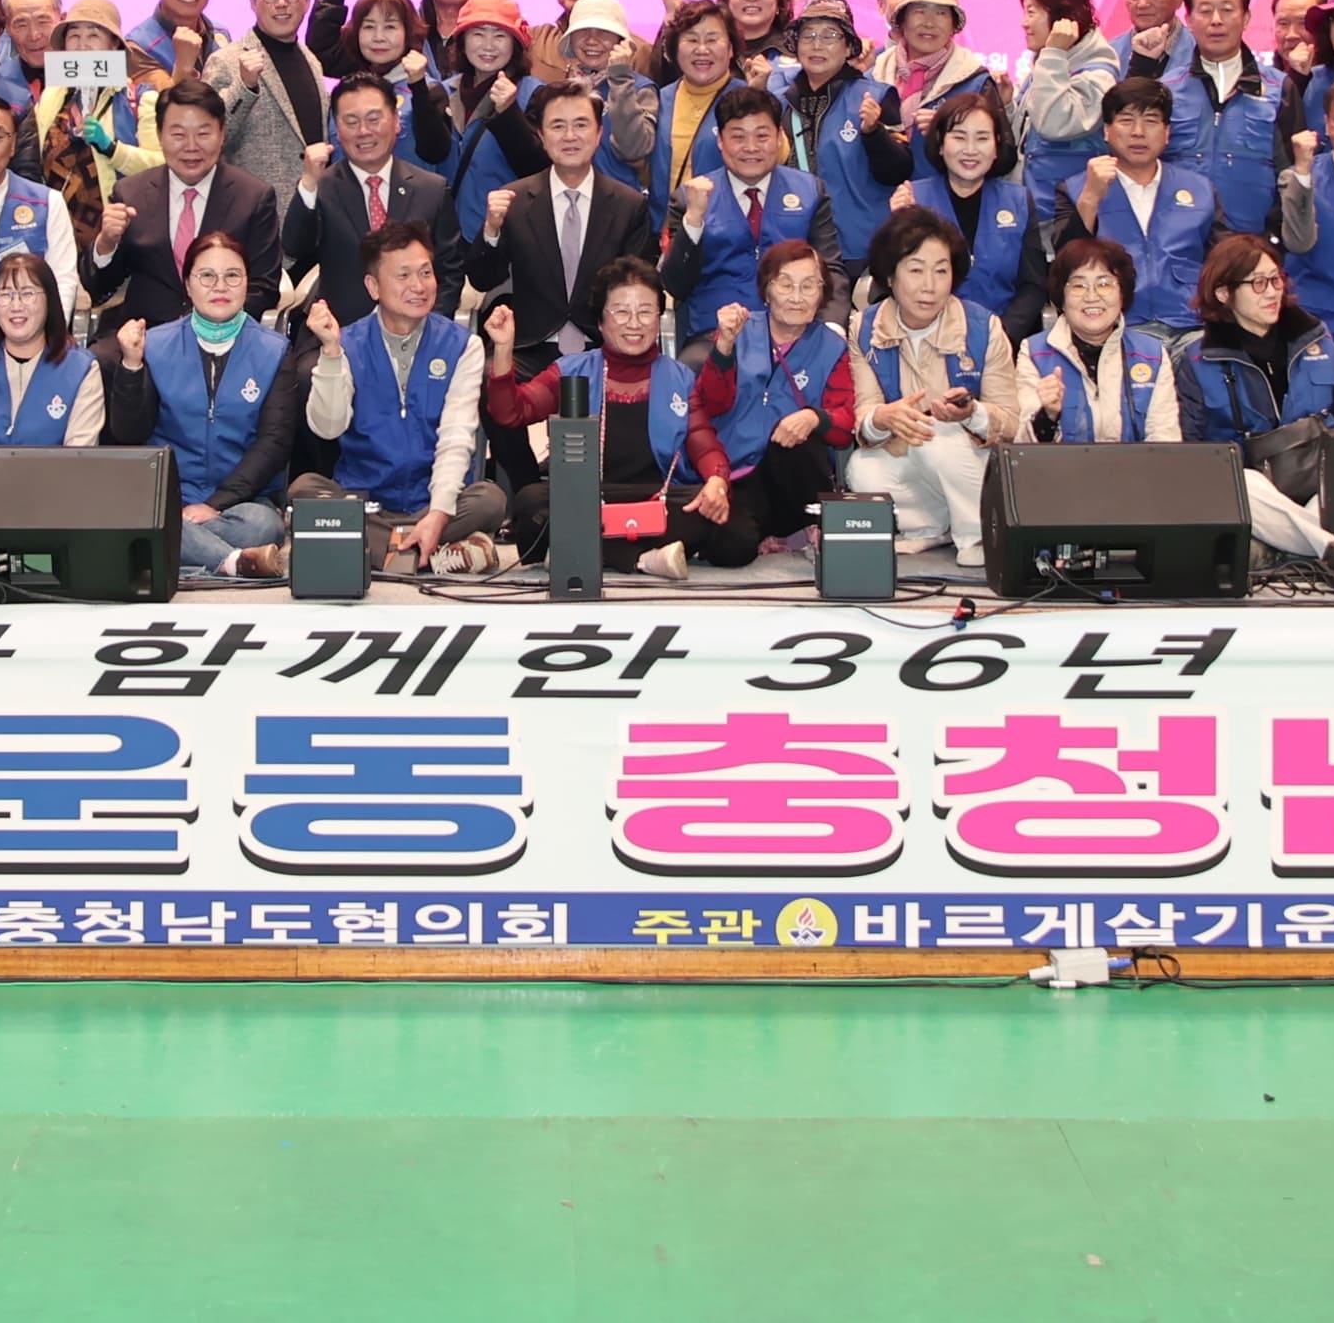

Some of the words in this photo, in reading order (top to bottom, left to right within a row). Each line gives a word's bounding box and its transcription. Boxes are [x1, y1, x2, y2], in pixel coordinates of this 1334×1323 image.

[89, 621, 690, 699] 함께한
[746, 626, 1237, 700] 36년
[631, 908, 763, 946] 주관
